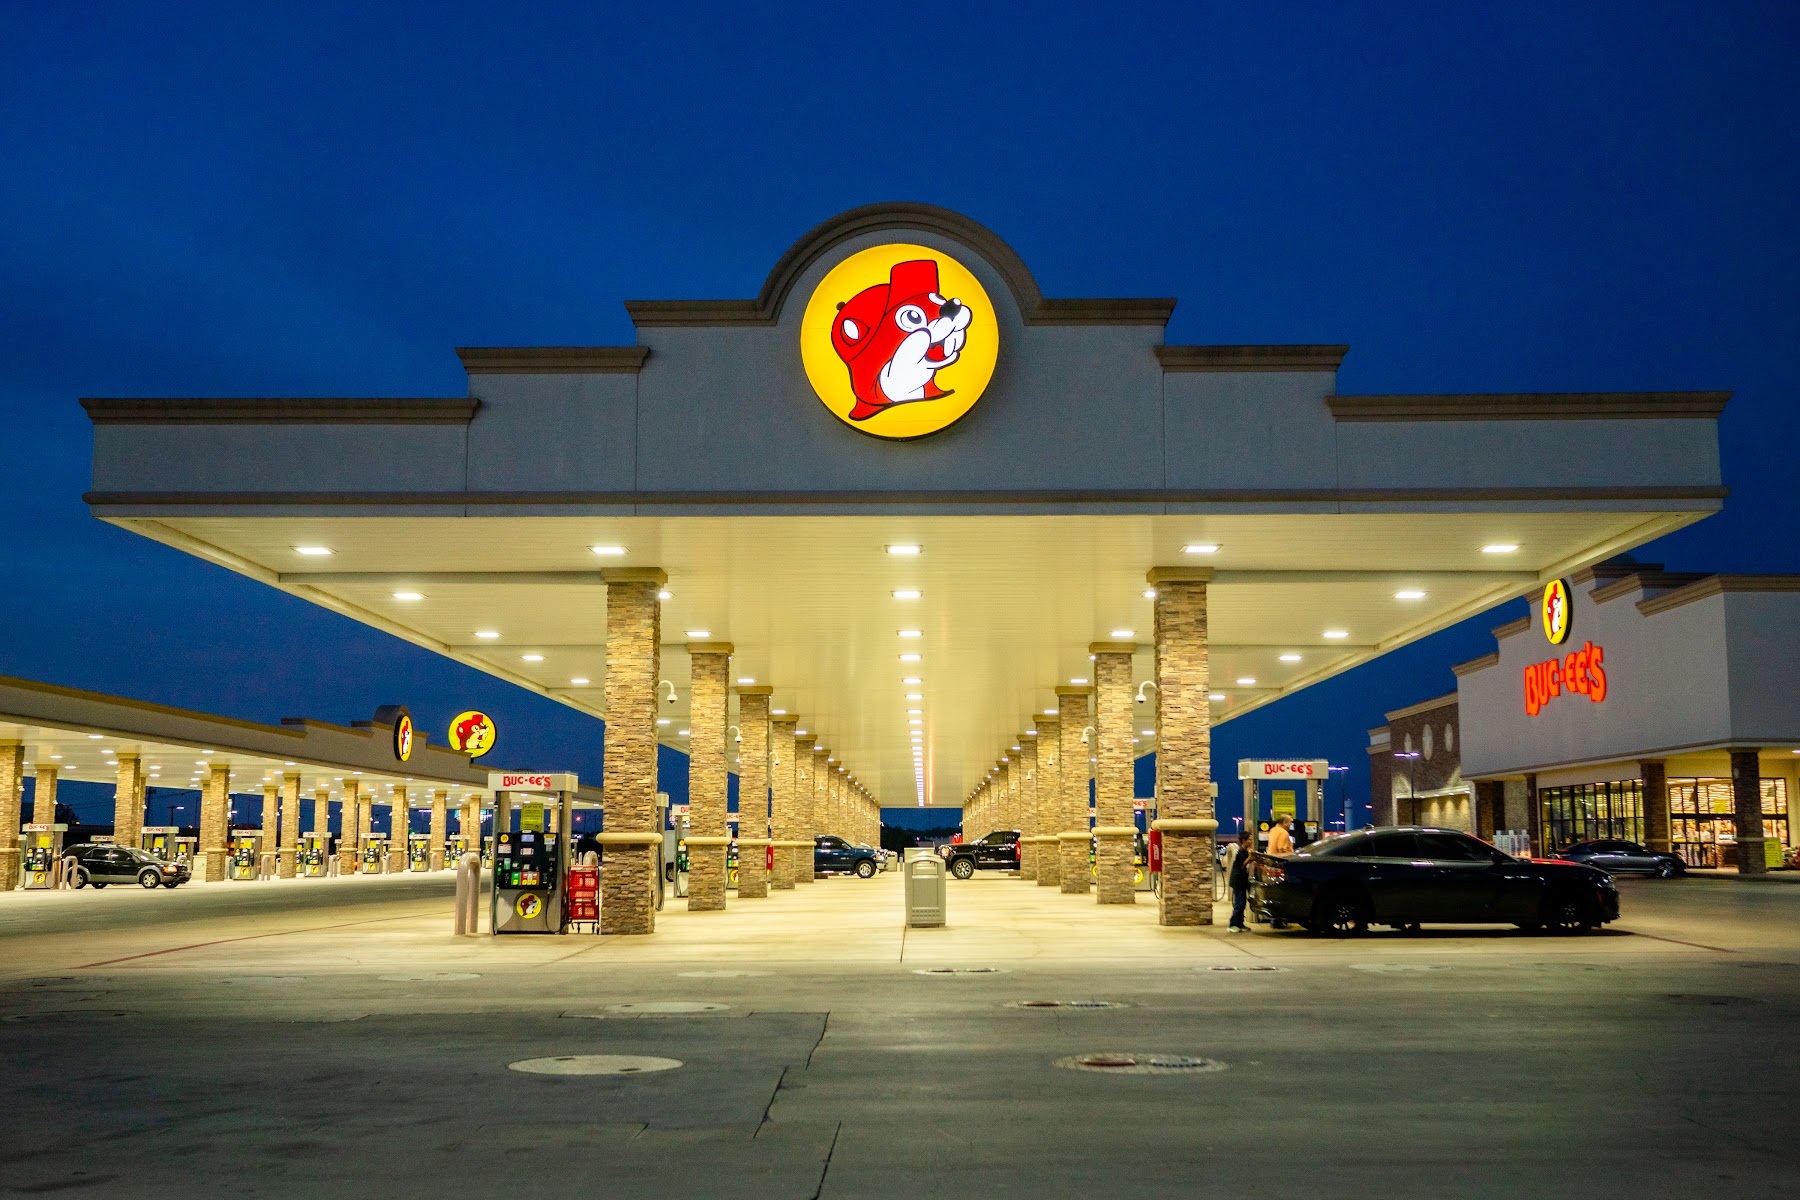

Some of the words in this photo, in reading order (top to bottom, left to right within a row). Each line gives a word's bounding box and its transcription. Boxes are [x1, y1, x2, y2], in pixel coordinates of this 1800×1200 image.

[1524, 641, 1606, 716] BUC-EE'S
[1264, 763, 1313, 776] BUC-EE'S
[503, 775, 551, 788] BUC-EE'S
